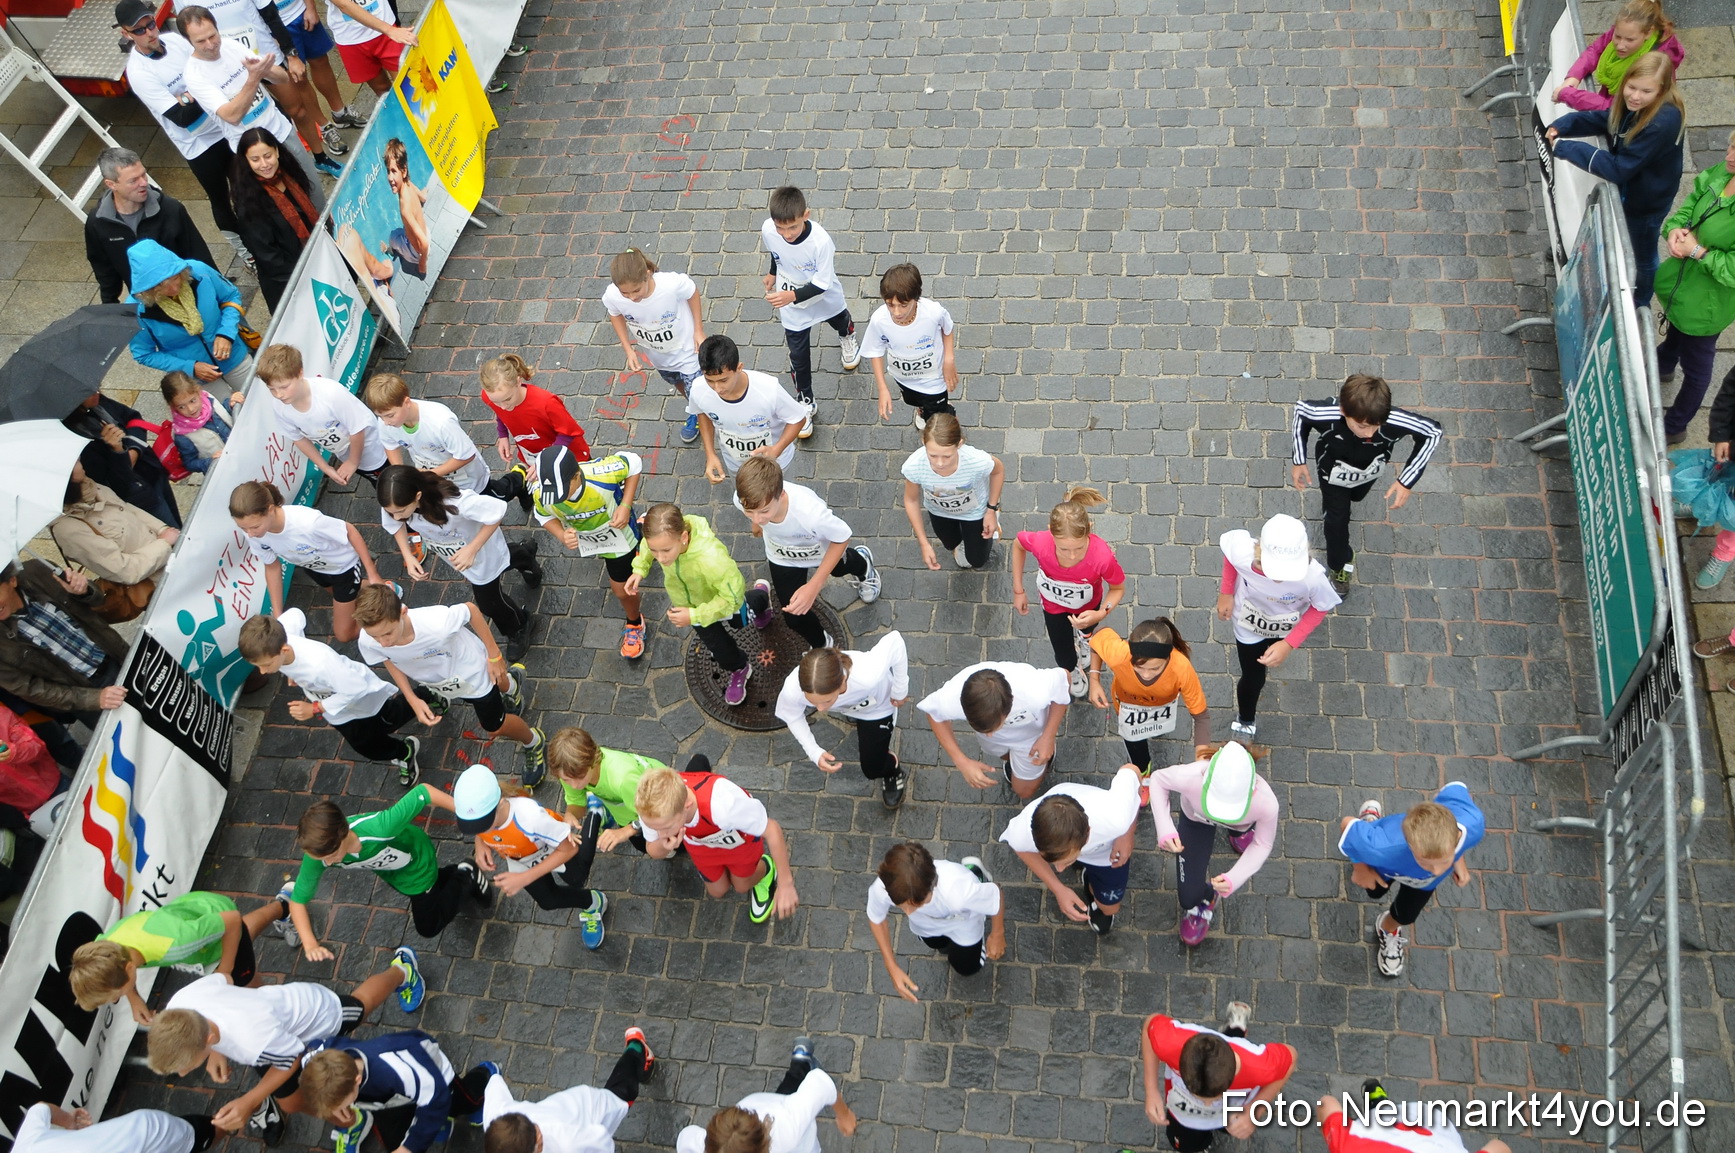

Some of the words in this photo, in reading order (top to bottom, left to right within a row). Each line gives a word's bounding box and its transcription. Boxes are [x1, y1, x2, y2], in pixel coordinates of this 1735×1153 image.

[428, 123, 443, 149] Pflaster
[434, 113, 460, 159] Außenplatten
[439, 136, 457, 169] Palisaden
[445, 155, 459, 179] Stufen
[636, 329, 674, 343] 4040
[892, 358, 933, 371] 4025
[1587, 366, 1598, 417] Fun
[1594, 416, 1603, 442] &
[725, 437, 768, 452] 4004
[1578, 393, 1599, 492] sicheren
[1595, 490, 1614, 600] Bahnen!
[1598, 443, 1614, 526] Action
[578, 528, 618, 543] 4051
[1576, 468, 1588, 521] Service
[1588, 560, 1599, 607] 09181
[1610, 523, 1618, 557] in
[776, 548, 821, 558] 4002
[1041, 582, 1085, 600] 4021
[1245, 613, 1293, 632] 4003
[150, 664, 169, 692] Erdgas
[168, 678, 184, 706] Wasser
[1124, 706, 1171, 726] 4044
[210, 712, 222, 752] Stadtbusse
[1131, 724, 1163, 736] Michelle
